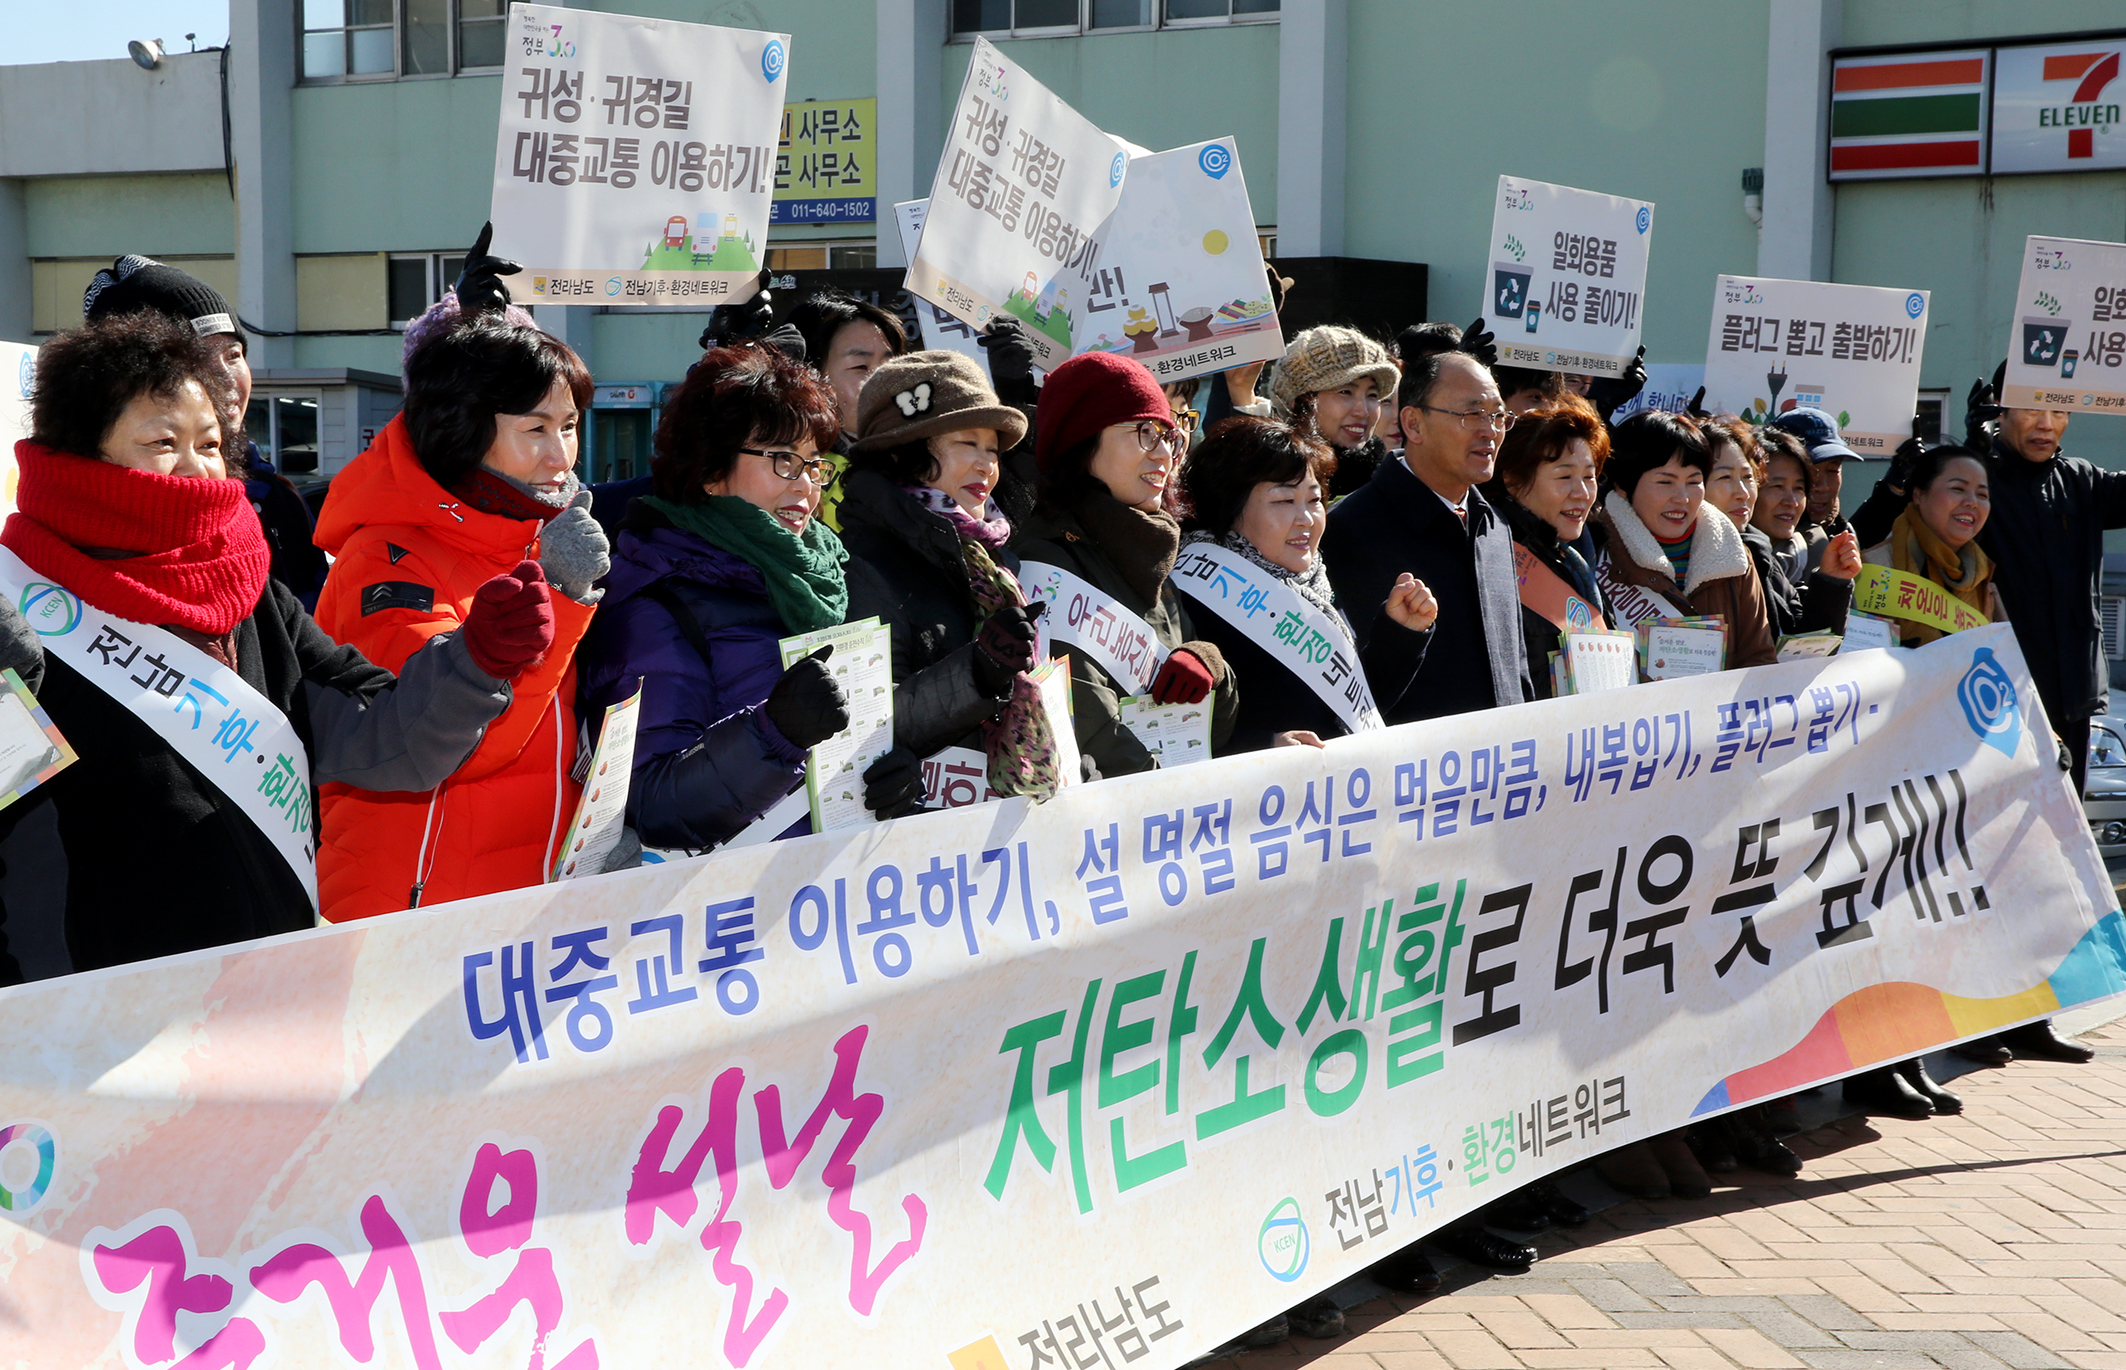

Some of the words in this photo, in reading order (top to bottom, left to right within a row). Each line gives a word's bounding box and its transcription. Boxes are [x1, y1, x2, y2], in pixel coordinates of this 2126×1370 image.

[522, 36, 544, 56] 정부
[799, 109, 861, 145] 사무소
[513, 131, 640, 189] 대중교통
[651, 140, 770, 194] 이용하기!
[799, 152, 861, 188] 사무소
[792, 202, 870, 218] 011-640-1502
[948, 148, 1025, 233] 대중교통
[1025, 201, 1098, 282] 이용하기!
[1553, 231, 1617, 278] 일회용품
[551, 279, 594, 296] 전라남도
[947, 287, 974, 313] 전라남도
[1545, 281, 1579, 323] 사용
[1584, 286, 1637, 330] 줄이기!
[1725, 292, 1741, 304] 정부
[1514, 350, 1539, 361] 전라남도
[1721, 315, 1780, 353] 플러그
[1786, 319, 1826, 356] 뽑고
[1832, 322, 1916, 364] 출발하기!
[2083, 331, 2126, 367] 사용
[1146, 345, 1236, 375] ·환경네트워크
[2045, 393, 2075, 404] 전라남도
[40, 595, 64, 619] KCEN
[1897, 580, 1948, 621] 체온은
[463, 896, 765, 1064] 대중교통
[788, 841, 1061, 985] 이용하기,
[1075, 822, 1128, 925] 설
[1142, 798, 1236, 907] 명절
[1249, 766, 1377, 880] 음식은
[1394, 738, 1548, 841] 먹을만큼,
[1564, 709, 1702, 803] 내복입기,
[1710, 693, 1799, 773] 플러그
[1808, 680, 1860, 755] 뽑기
[624, 1024, 928, 1368] 설날
[983, 878, 1534, 1215] 저탄소생활로
[1554, 834, 1693, 1014] 더욱
[1711, 817, 1780, 978] 뜻
[1325, 1075, 1631, 1252] 전남기후·환경네트워크
[1274, 1233, 1297, 1253] KCEN
[1017, 1275, 1184, 1370] 전라남도
